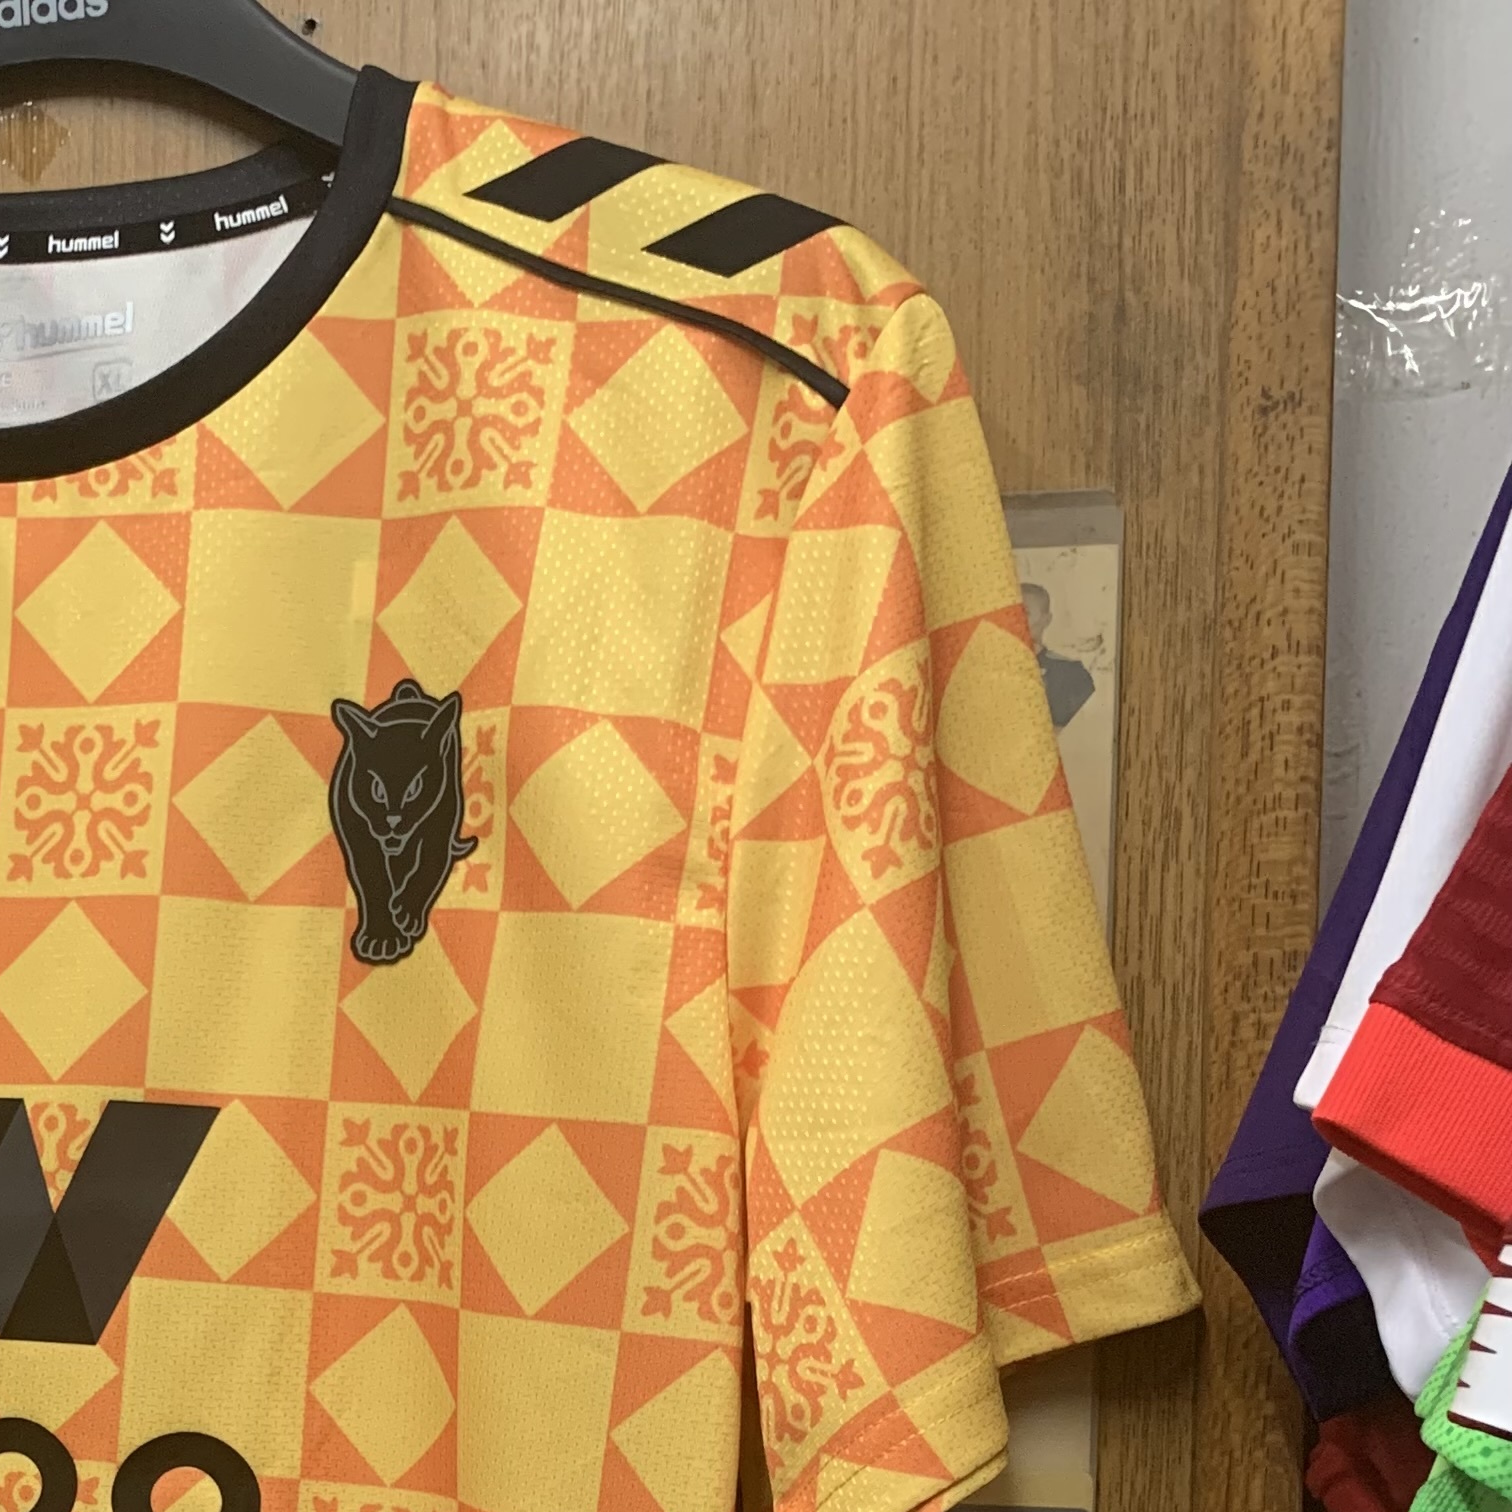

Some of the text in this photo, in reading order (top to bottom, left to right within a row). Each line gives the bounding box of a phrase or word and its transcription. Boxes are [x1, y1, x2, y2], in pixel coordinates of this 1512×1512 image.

[214, 194, 289, 232] hummel
[48, 229, 119, 254] hummel
[15, 301, 135, 351] hummel
